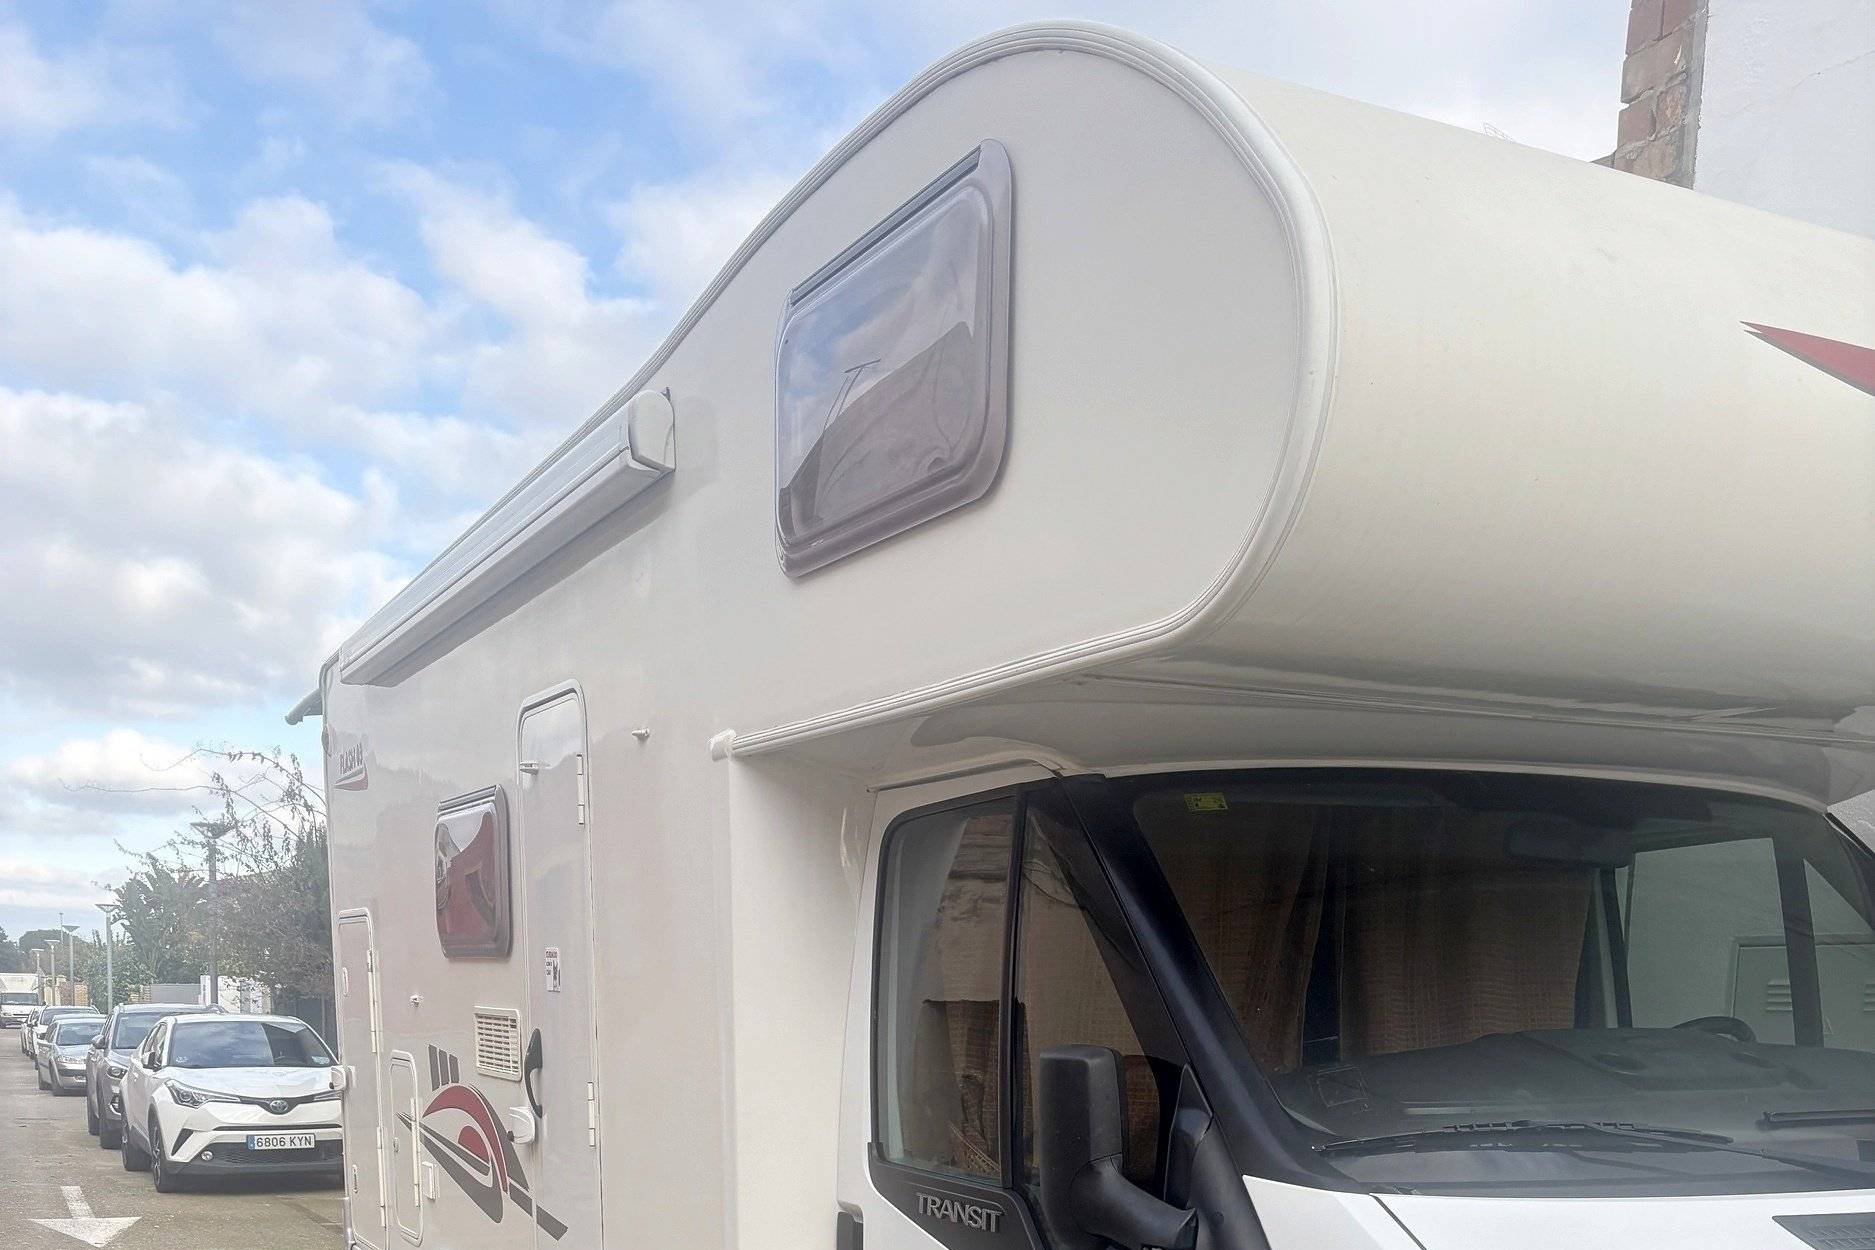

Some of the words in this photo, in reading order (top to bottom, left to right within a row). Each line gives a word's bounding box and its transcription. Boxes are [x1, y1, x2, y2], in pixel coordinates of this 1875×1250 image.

[256, 1137, 286, 1148] 6806
[289, 1135, 312, 1147] KYN
[916, 1192, 1001, 1233] TRANSIT
